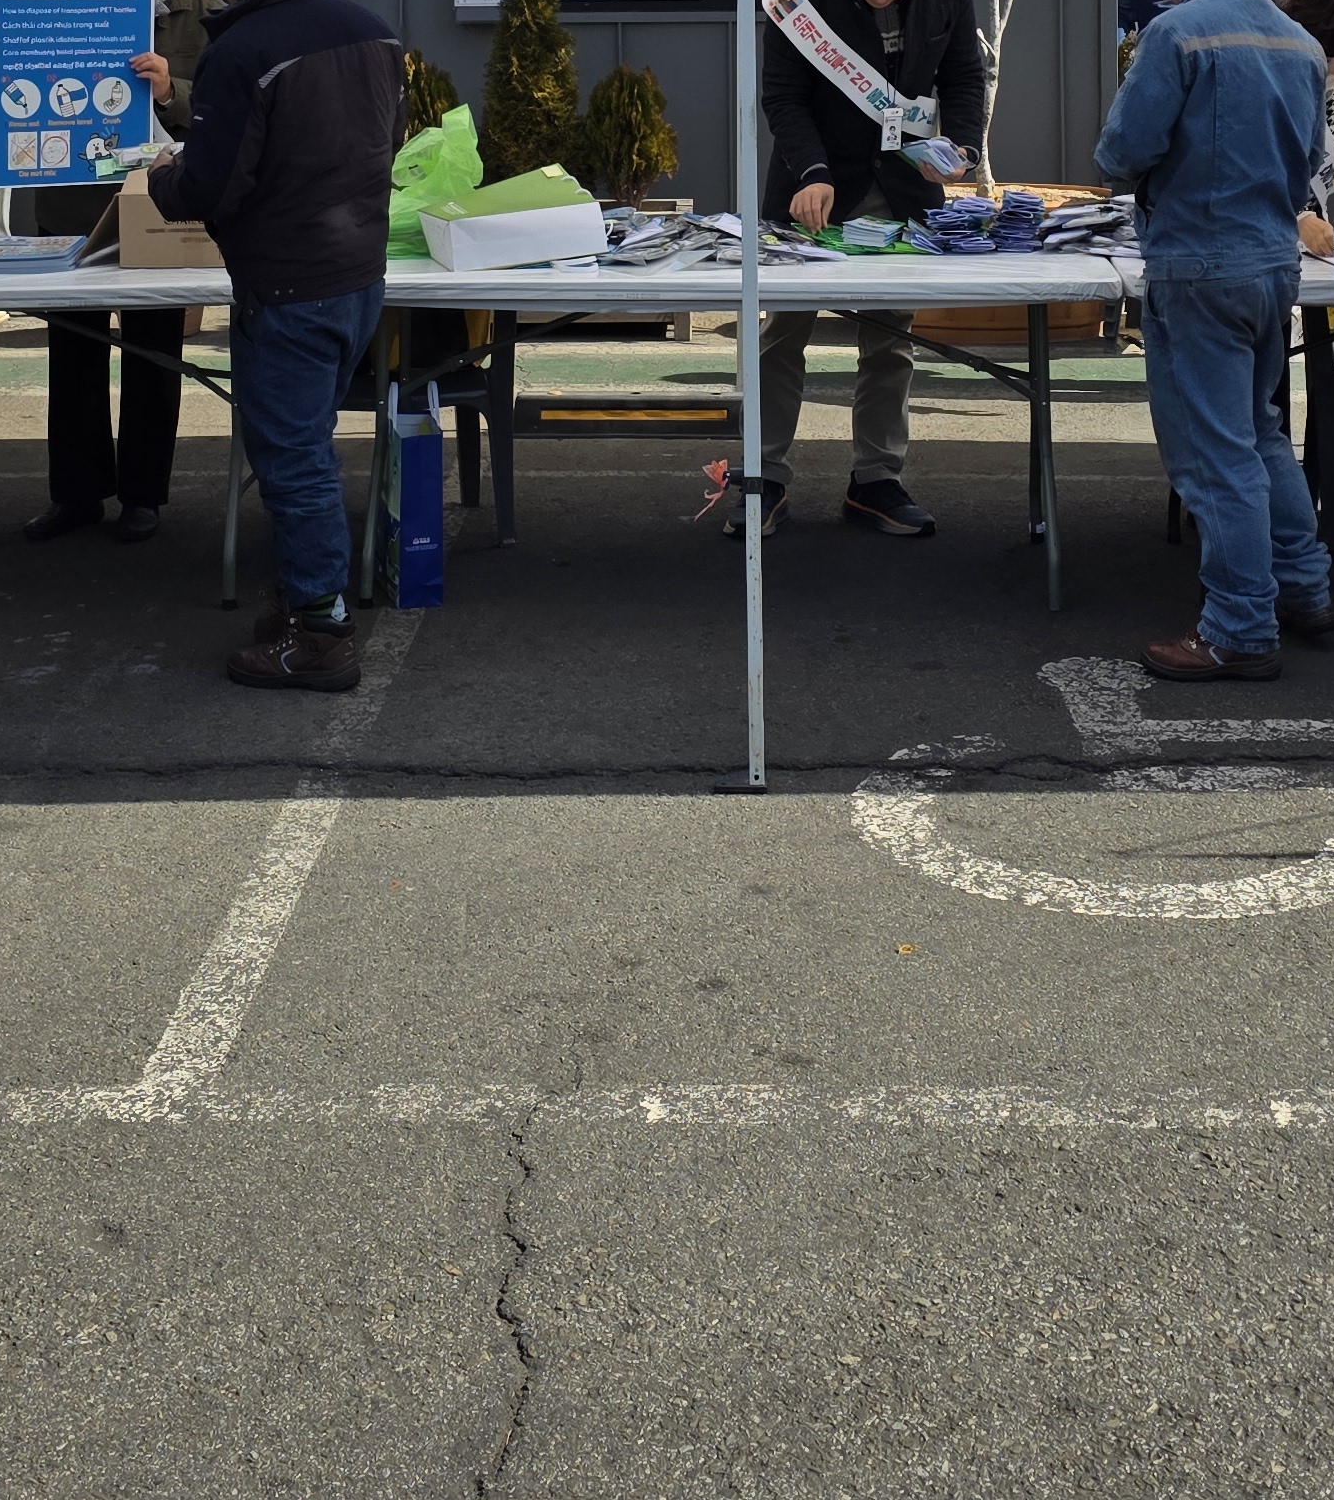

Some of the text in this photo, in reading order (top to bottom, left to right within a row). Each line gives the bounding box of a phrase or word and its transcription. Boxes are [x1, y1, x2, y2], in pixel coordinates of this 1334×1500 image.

[26, 7, 52, 15] dispose
[99, 6, 113, 14] PET
[792, 12, 873, 94] 쓰레기 무단투기 NO
